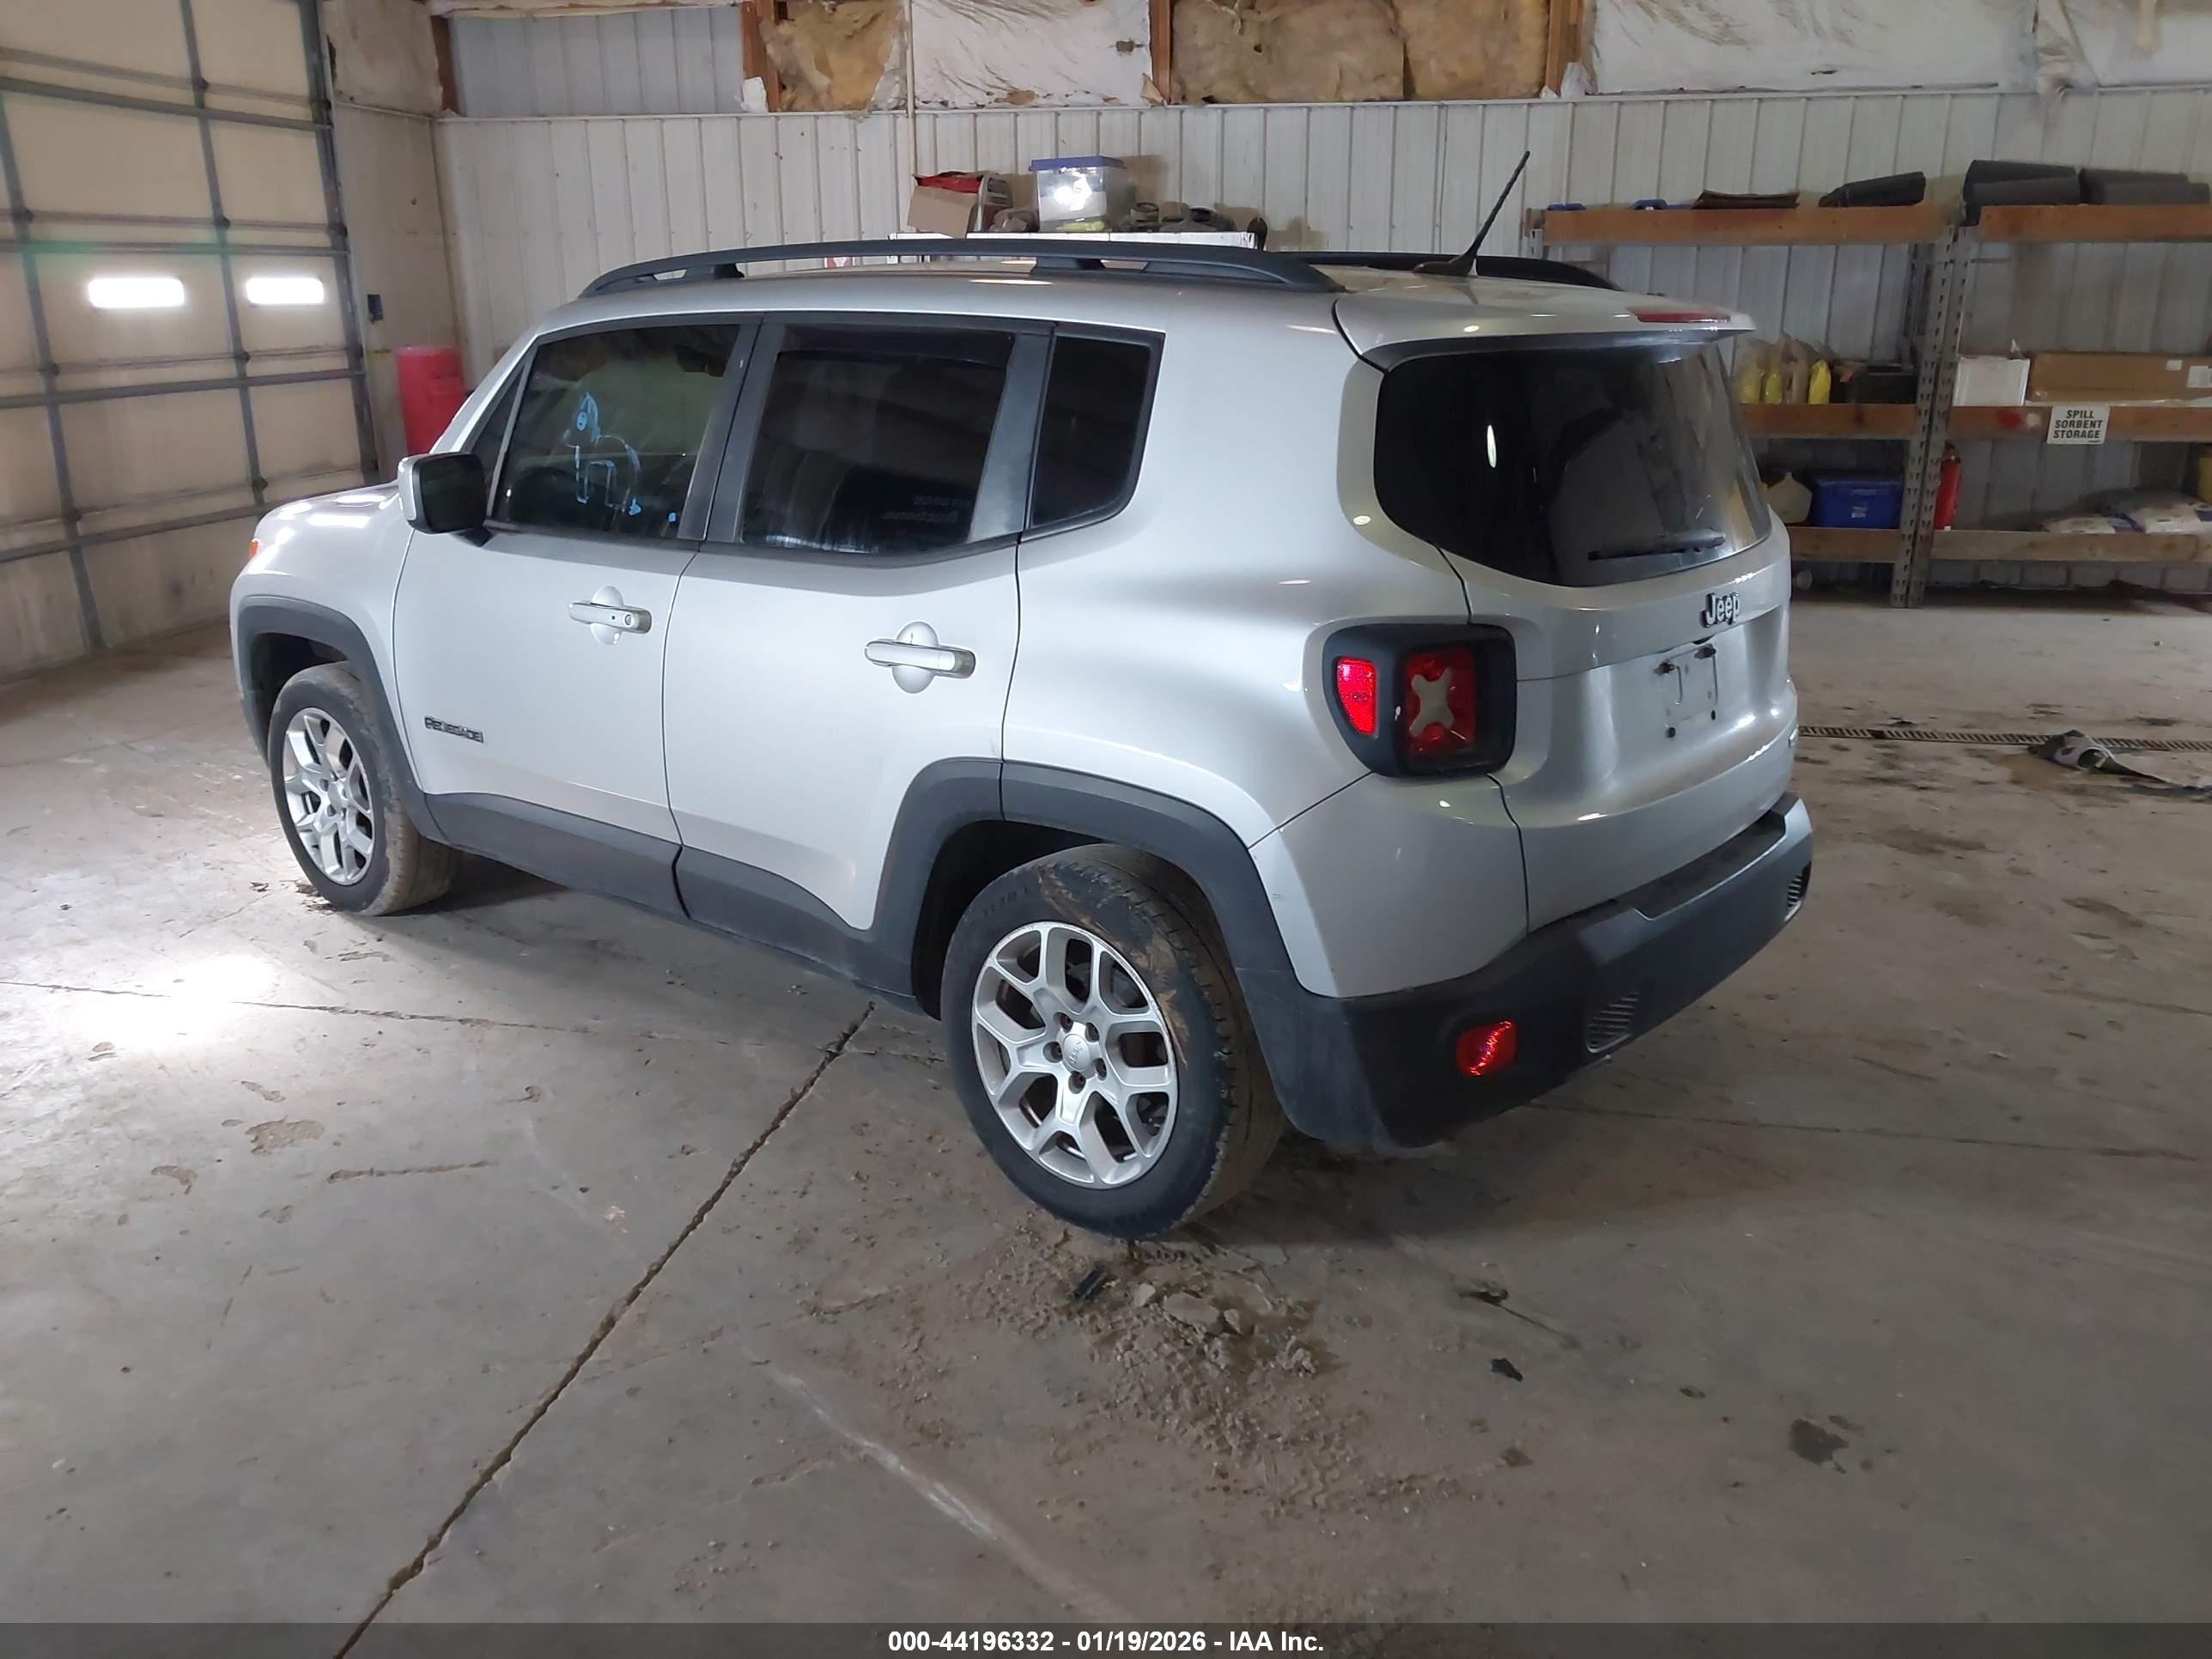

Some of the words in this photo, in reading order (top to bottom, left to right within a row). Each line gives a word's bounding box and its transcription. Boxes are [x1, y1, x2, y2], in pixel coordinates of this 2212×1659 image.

[2066, 410, 2094, 419] SPILL
[2054, 420, 2103, 428] SORBENT
[2053, 430, 2101, 439] STORAGE
[1703, 592, 1740, 626] Jeep
[424, 716, 483, 744] REEGADE
